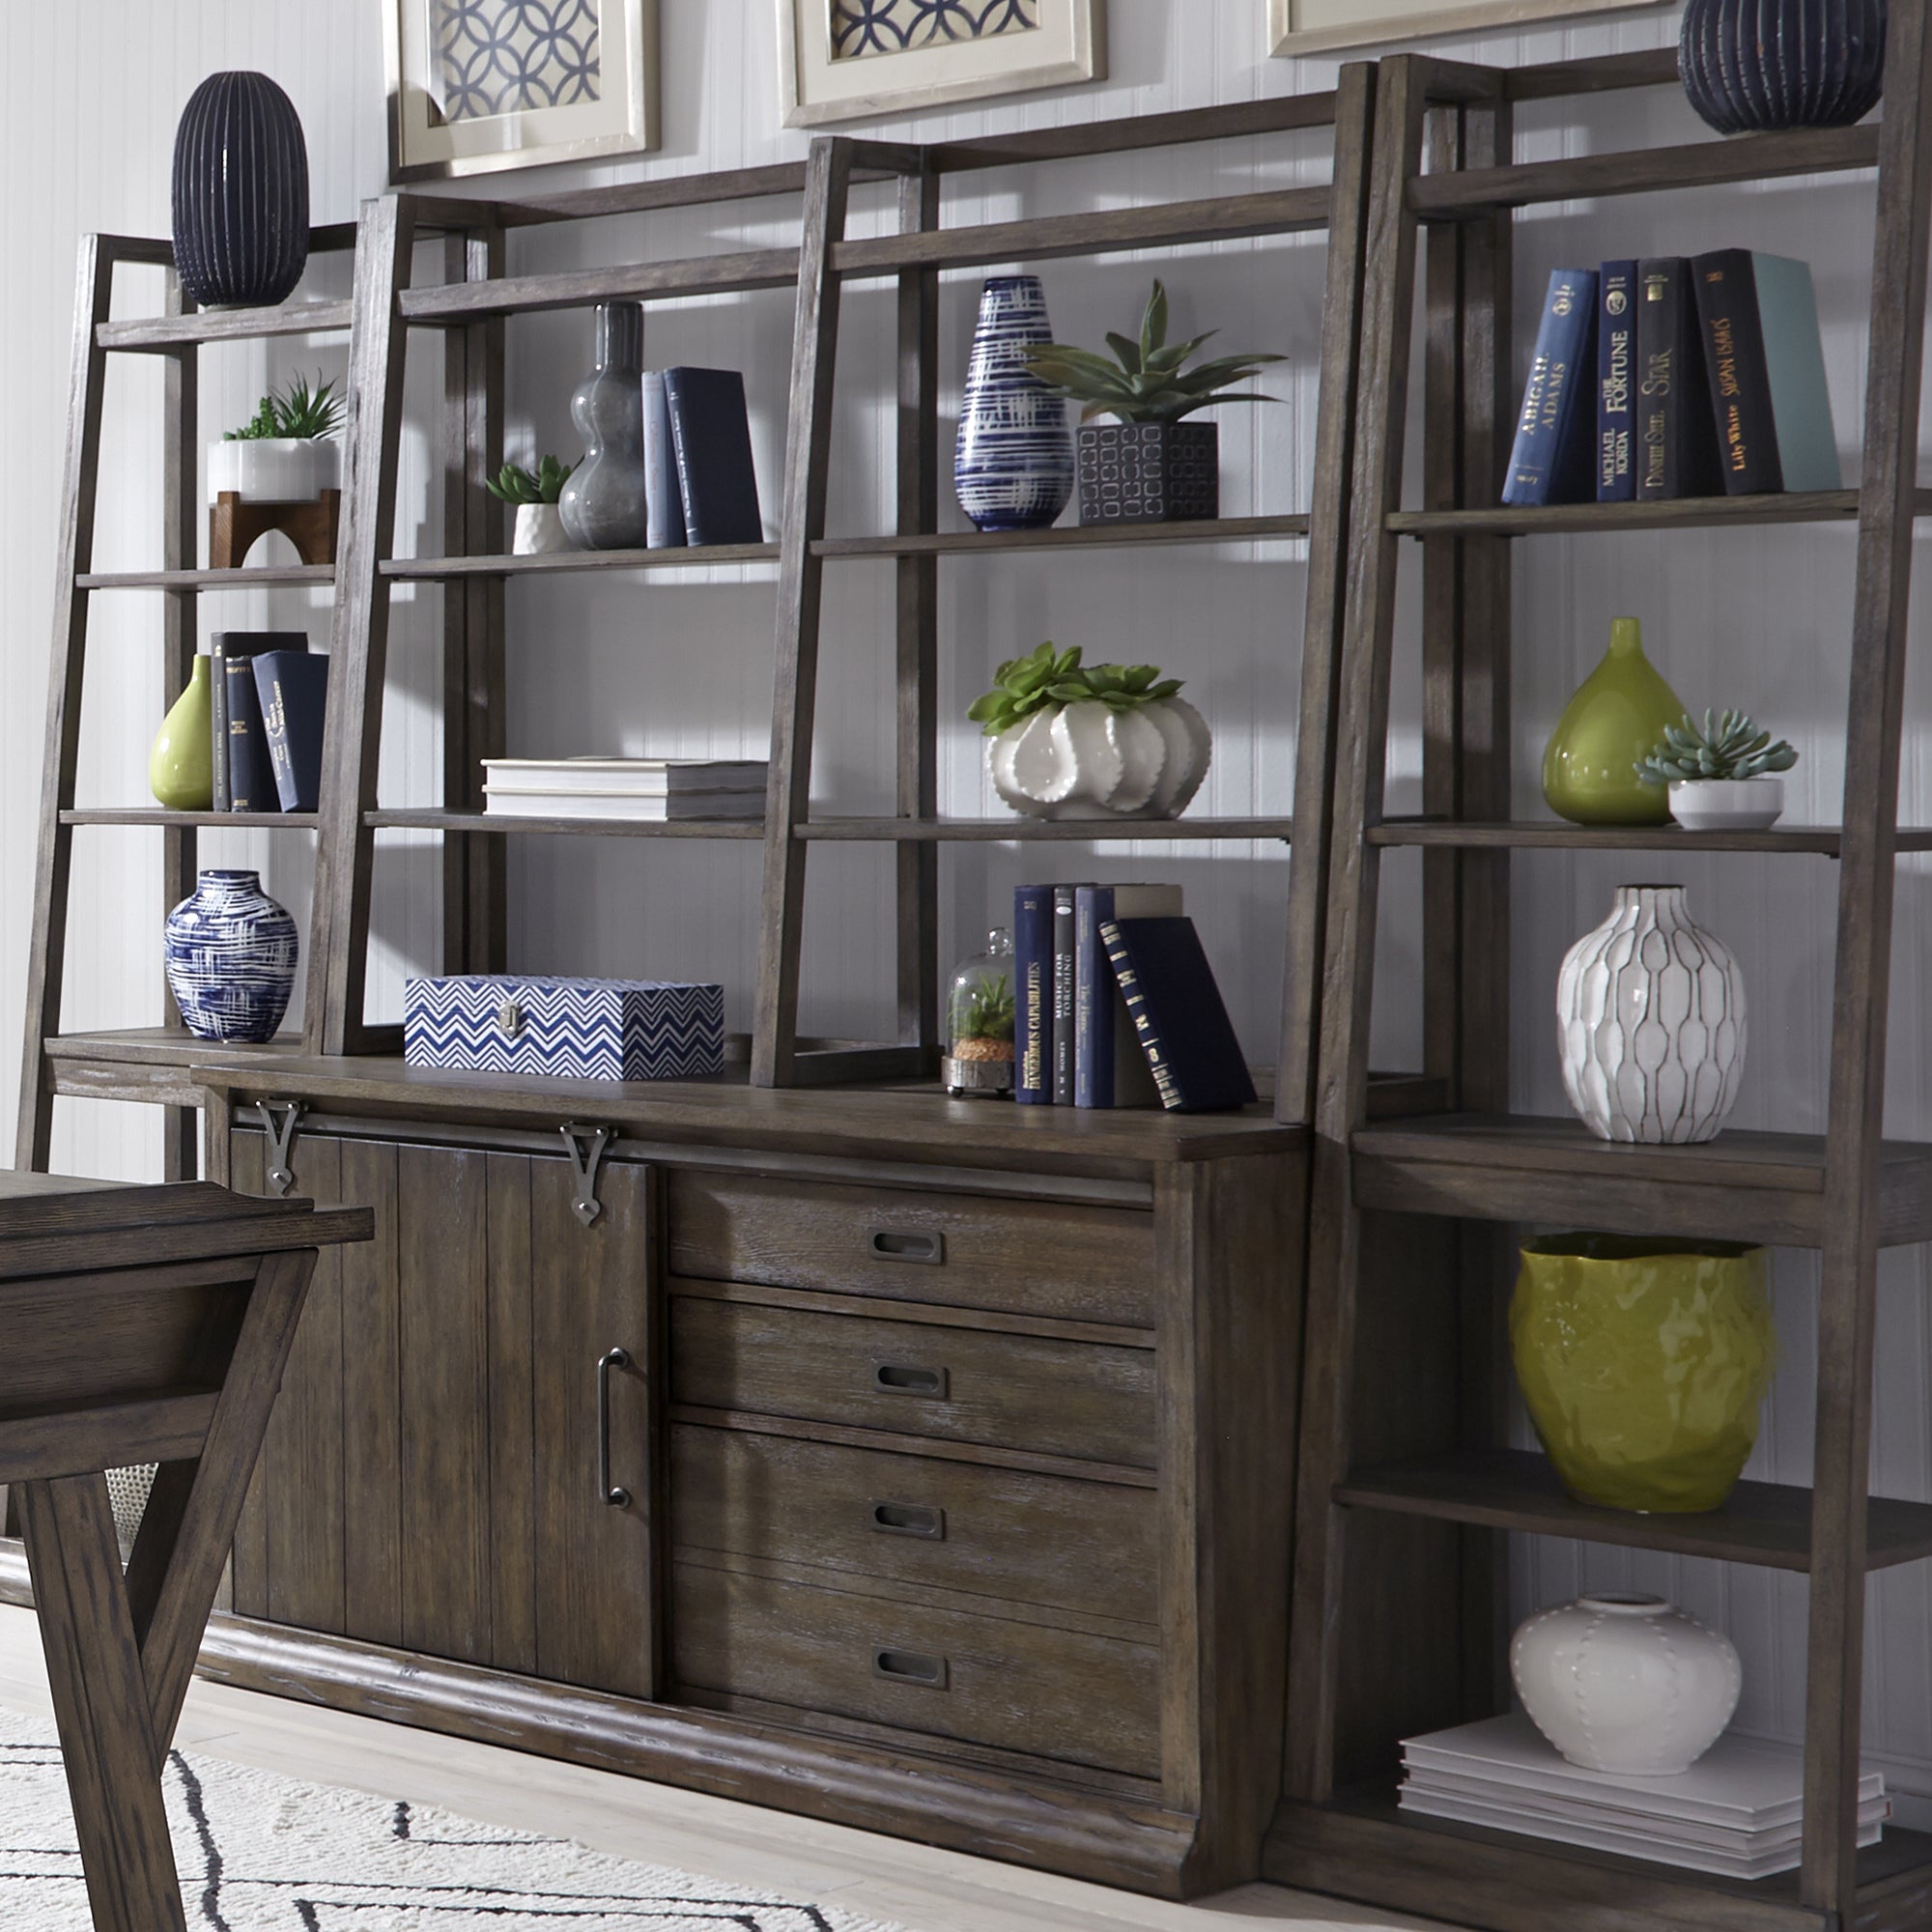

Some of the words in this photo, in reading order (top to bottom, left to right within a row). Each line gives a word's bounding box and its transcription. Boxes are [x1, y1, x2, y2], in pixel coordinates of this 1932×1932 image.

[1712, 317, 1733, 355] ISAACS
[1522, 353, 1548, 435] ABIGAIL
[1604, 379, 1612, 399] THE
[1606, 330, 1628, 413] FORTUNE
[1641, 349, 1671, 397] STAR
[1719, 357, 1739, 397] SUSAN
[1543, 362, 1566, 430] ADAMS
[1729, 405, 1743, 444] White
[1604, 428, 1615, 486] MICHAEL
[1616, 431, 1628, 474] KORDA
[1732, 443, 1747, 471] Lily
[1028, 961, 1040, 1030] CAPABILITIES
[1028, 1031, 1040, 1090] DANGEROUS
